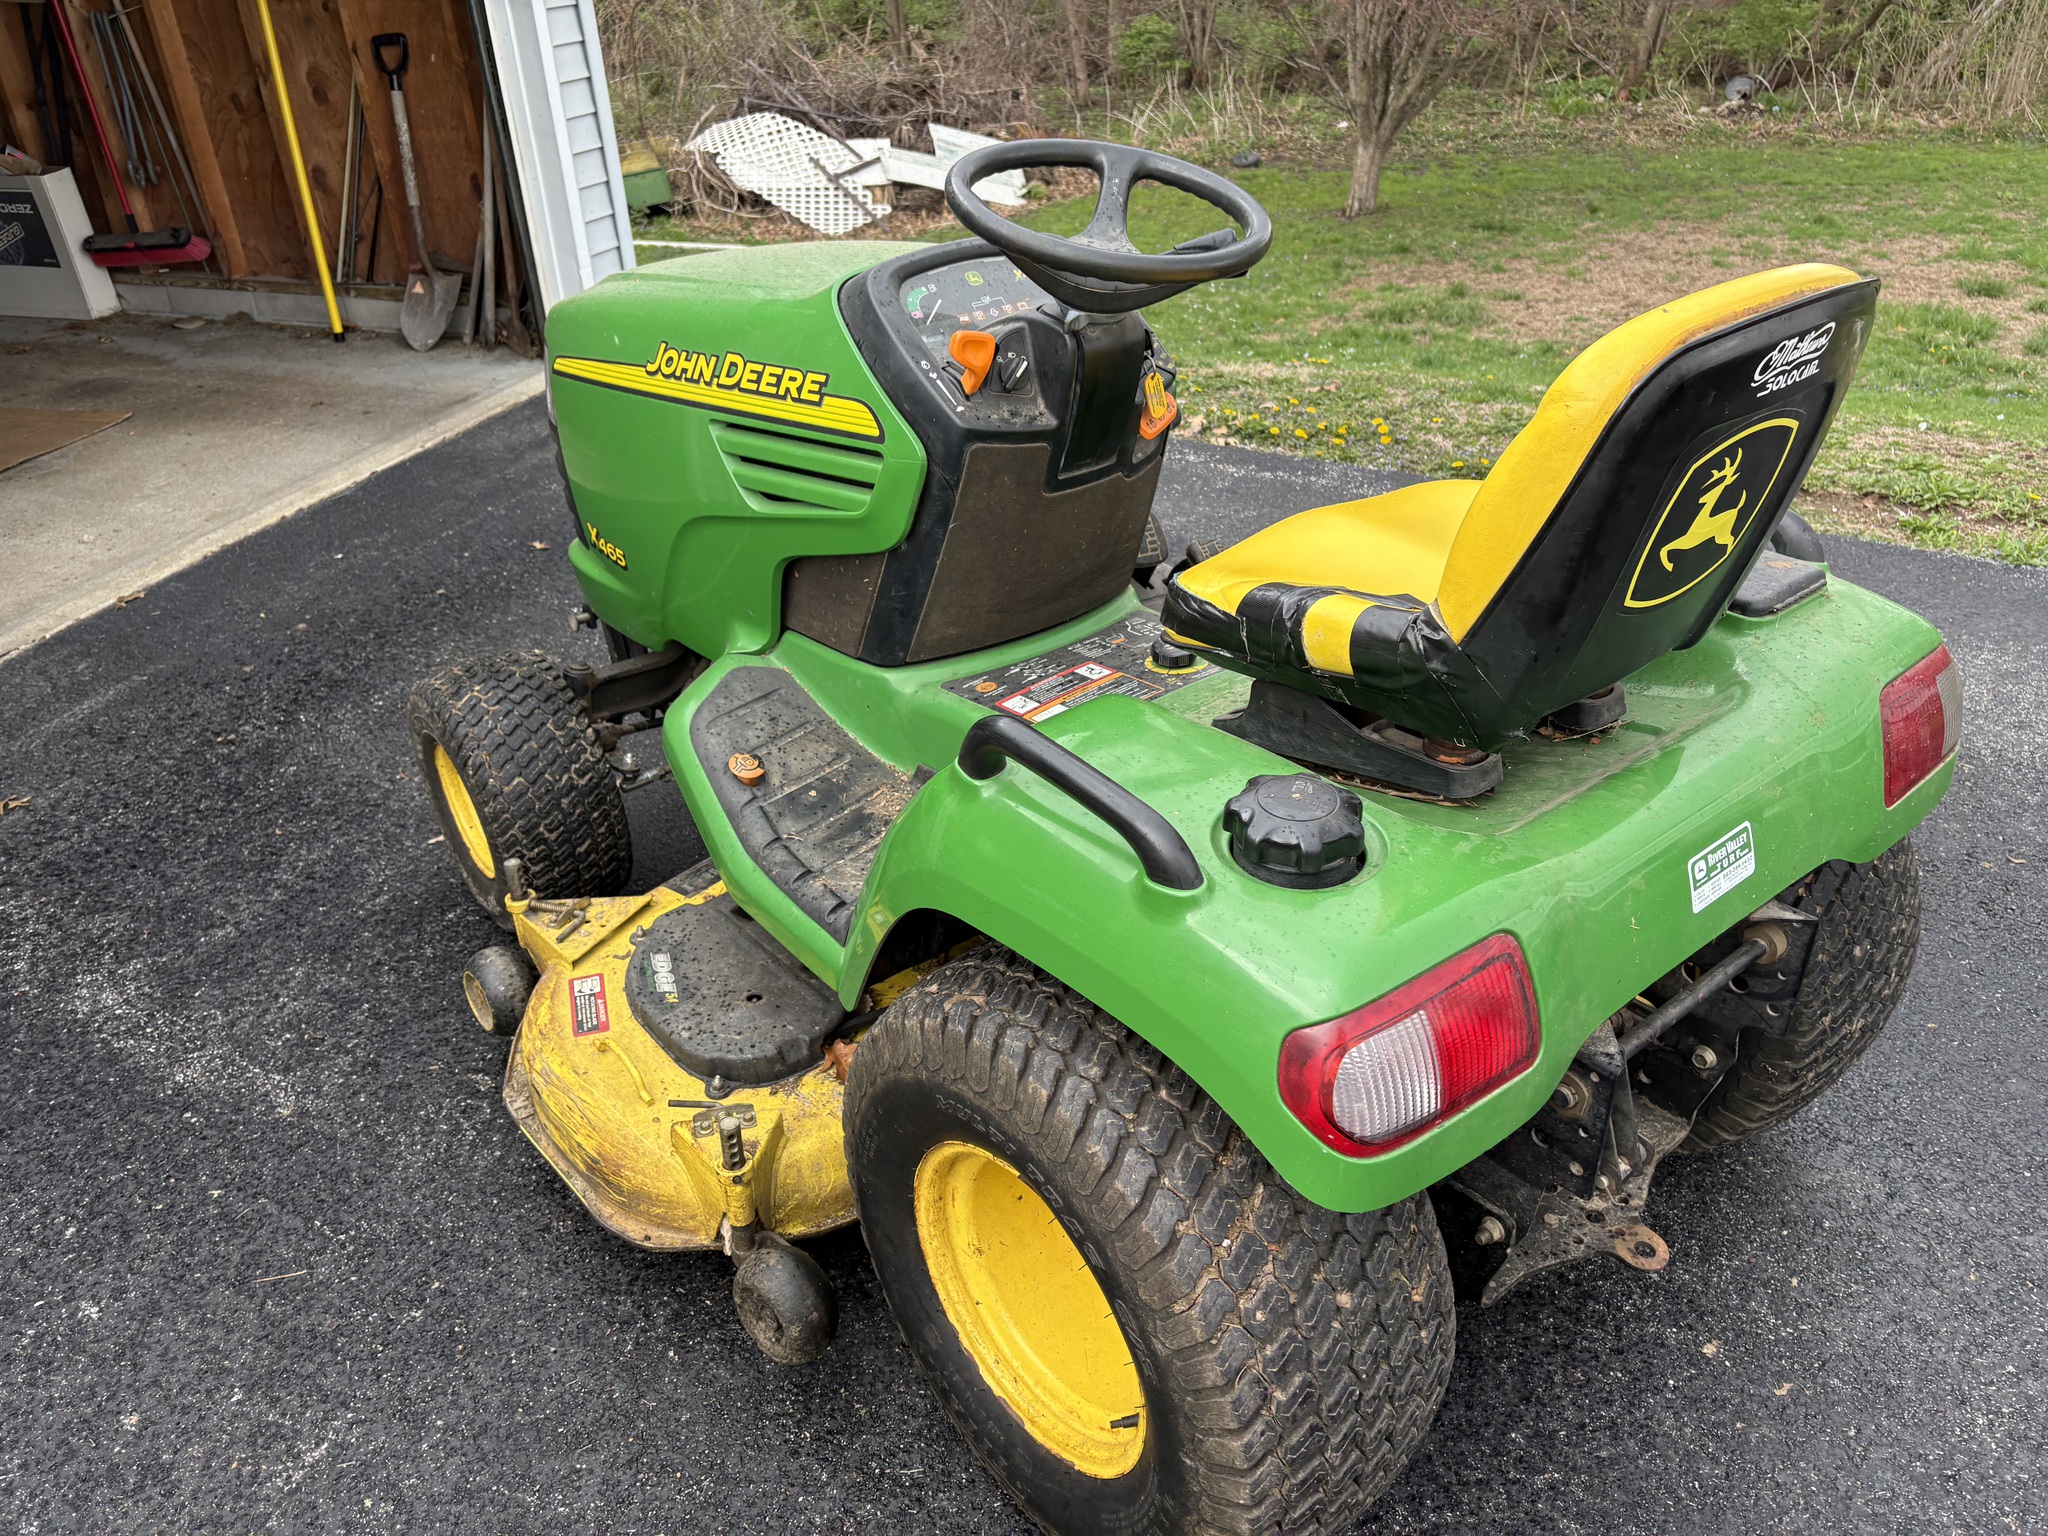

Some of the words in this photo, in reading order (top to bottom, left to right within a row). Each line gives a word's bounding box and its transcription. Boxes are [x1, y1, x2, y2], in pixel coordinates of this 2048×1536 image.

[645, 341, 718, 385] JOHN
[717, 352, 829, 406] DEERE
[586, 521, 628, 570] X465
[1707, 846, 1727, 868] RIVER
[1726, 832, 1747, 854] VALLEY
[1713, 848, 1746, 874] TURF
[650, 952, 677, 993] EDGE
[665, 992, 679, 1003] 54
[935, 1094, 1016, 1154] MULTI
